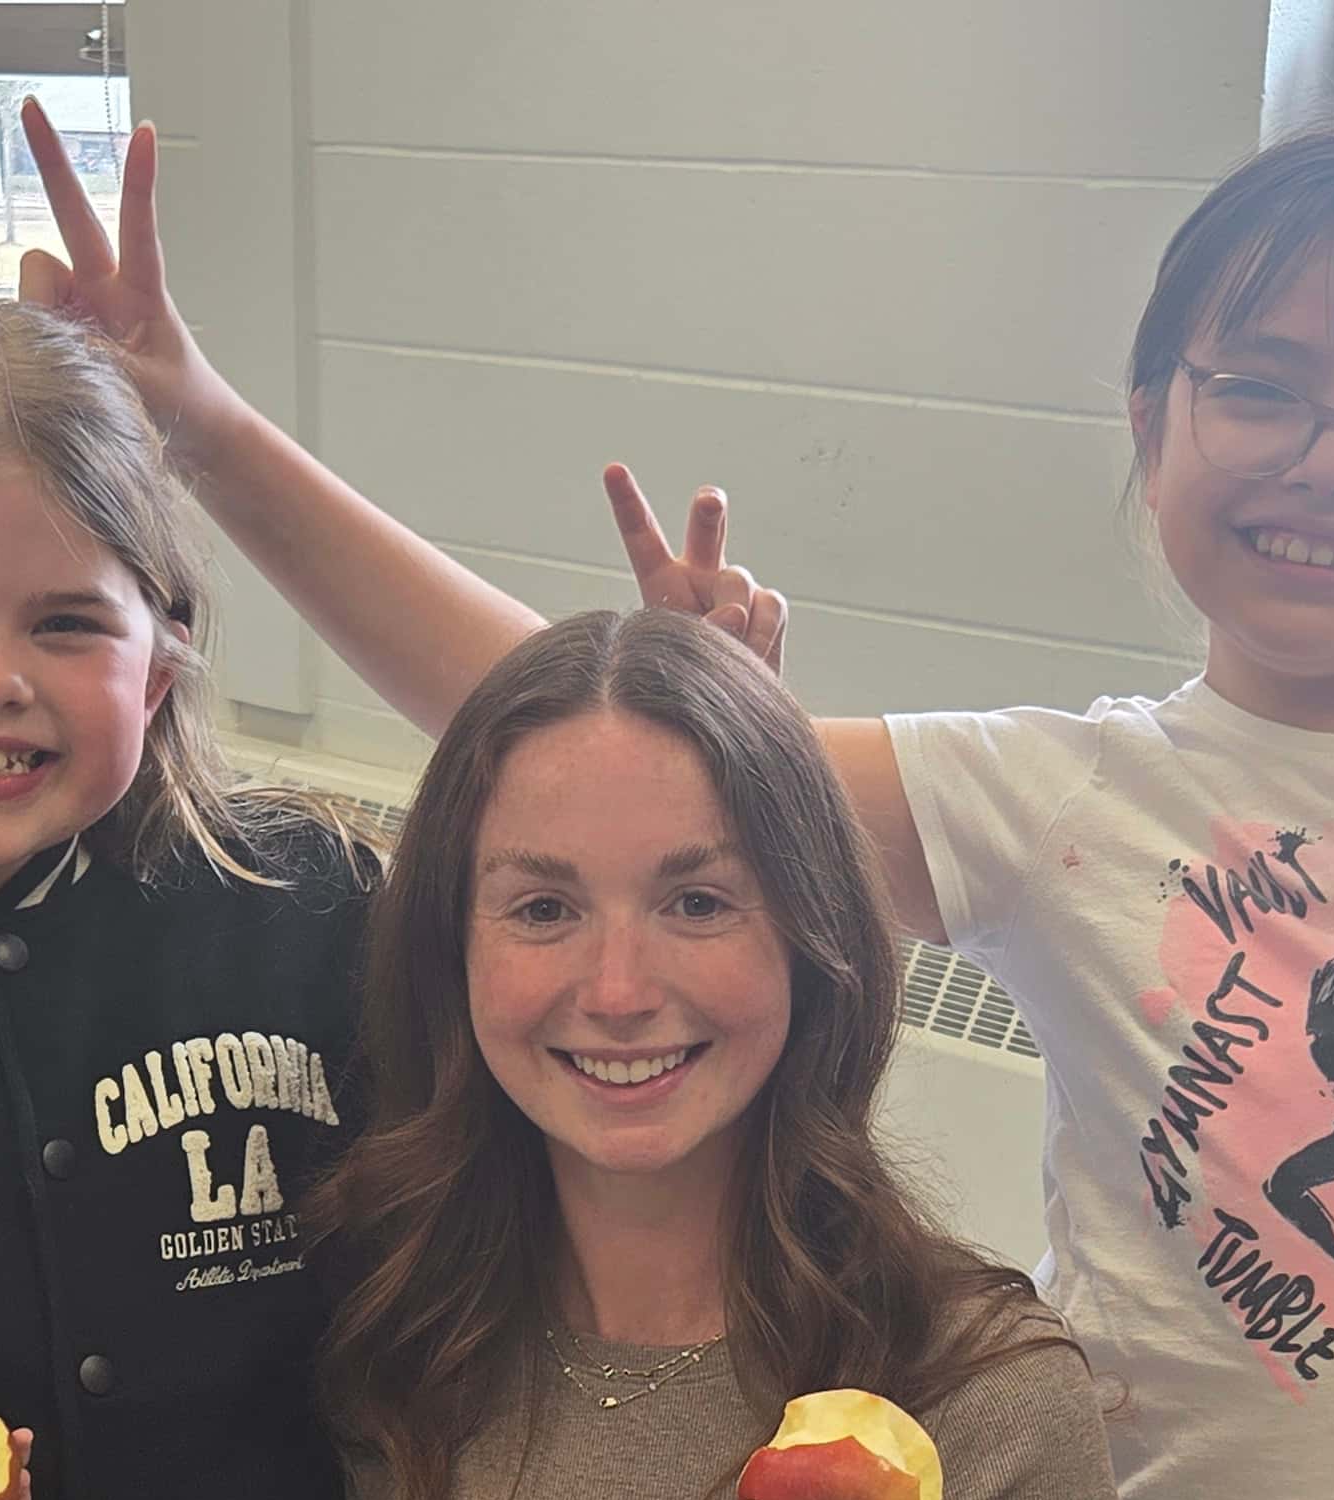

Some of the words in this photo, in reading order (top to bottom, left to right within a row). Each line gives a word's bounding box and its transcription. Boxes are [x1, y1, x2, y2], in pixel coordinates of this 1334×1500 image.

[1181, 831, 1328, 945] VAULT
[94, 1031, 340, 1155] CALIFORNIA
[1139, 951, 1283, 1229] GYMNAST
[181, 1124, 284, 1223] LA
[160, 1224, 245, 1260] GOLDEN
[250, 1213, 301, 1247] STAT
